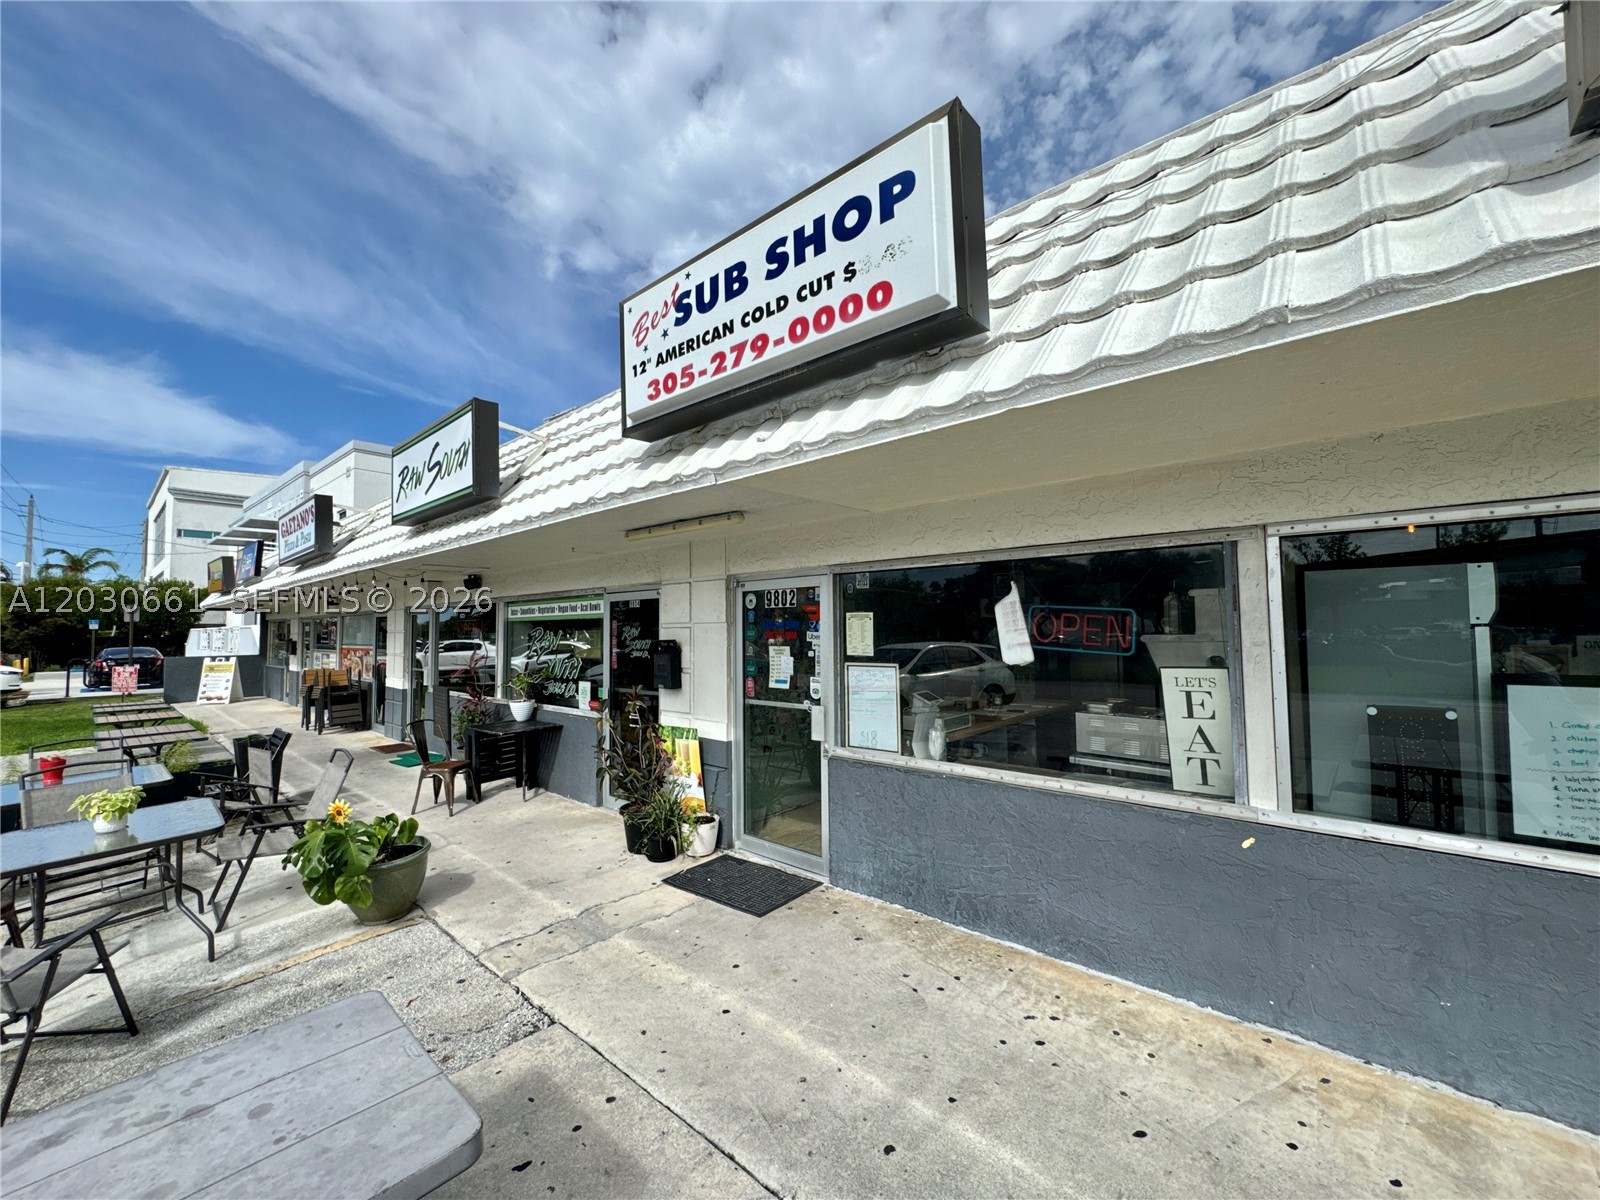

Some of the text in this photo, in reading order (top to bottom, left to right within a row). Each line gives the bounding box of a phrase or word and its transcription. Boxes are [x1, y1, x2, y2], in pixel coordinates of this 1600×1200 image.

[674, 261, 749, 327] SUB
[765, 170, 916, 281] SHOP
[632, 282, 680, 347] Best
[632, 357, 653, 378] 12"
[655, 319, 736, 368] AMERICAN
[740, 294, 790, 329] COLD
[796, 272, 836, 302] CUT
[647, 280, 894, 401] 305-279-0000
[396, 438, 471, 503] RAW SOUTH
[281, 504, 315, 539] GAETANO'S
[765, 589, 796, 607] 9802
[1033, 612, 1131, 648] OPEN
[1174, 676, 1217, 688] LET'S
[1179, 690, 1222, 787] EAT
